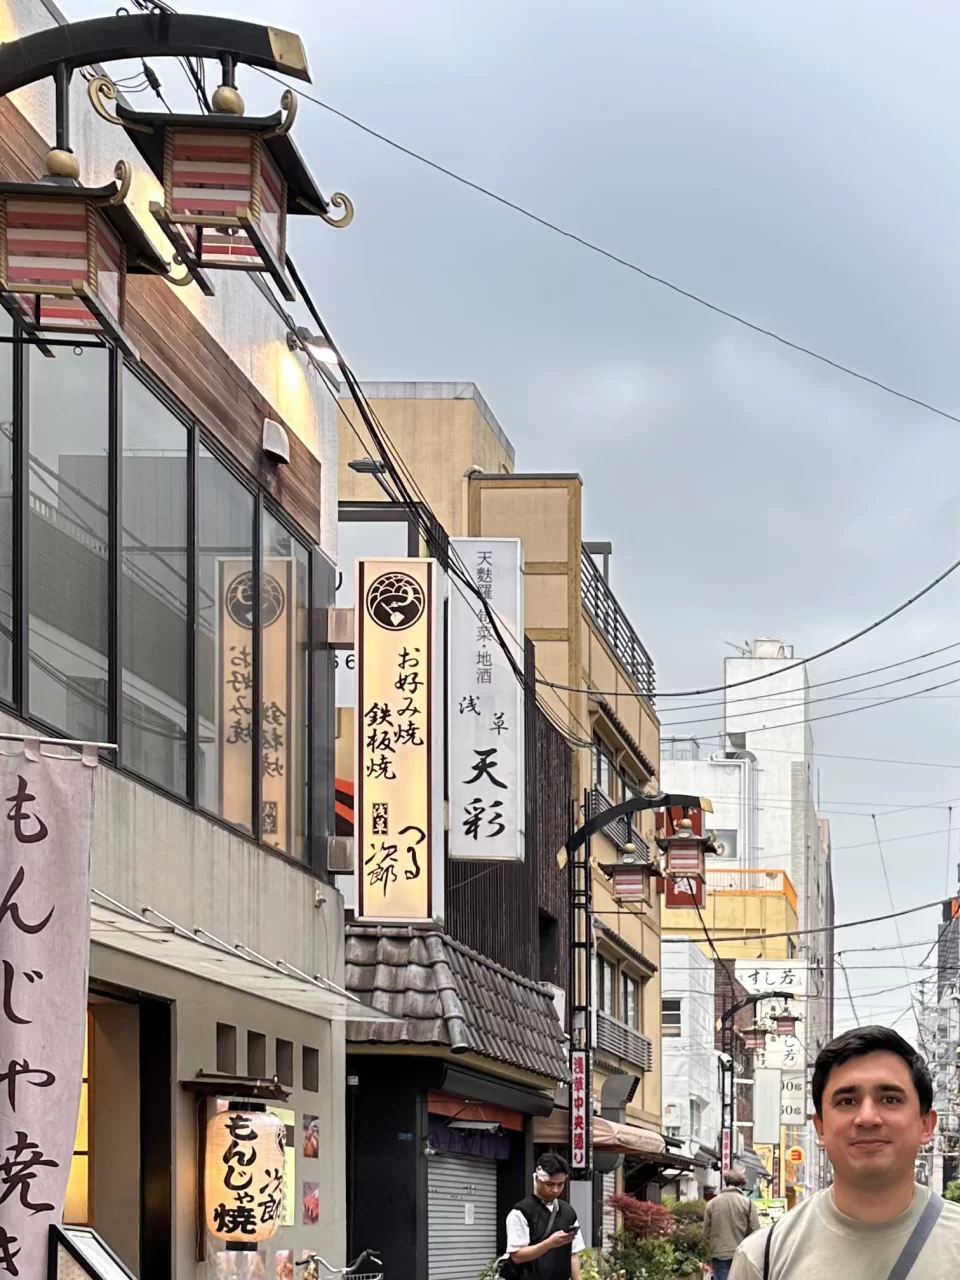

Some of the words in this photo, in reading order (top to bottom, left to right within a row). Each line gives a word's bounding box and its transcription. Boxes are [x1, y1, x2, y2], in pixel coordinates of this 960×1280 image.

[364, 702, 396, 780] 鉄板焼
[394, 646, 424, 746] お好み焼
[463, 748, 508, 840] 天彩
[748, 969, 796, 985] すし若
[573, 1056, 584, 1164] 浅草中央通り
[214, 1114, 258, 1234] もんじゃ焼
